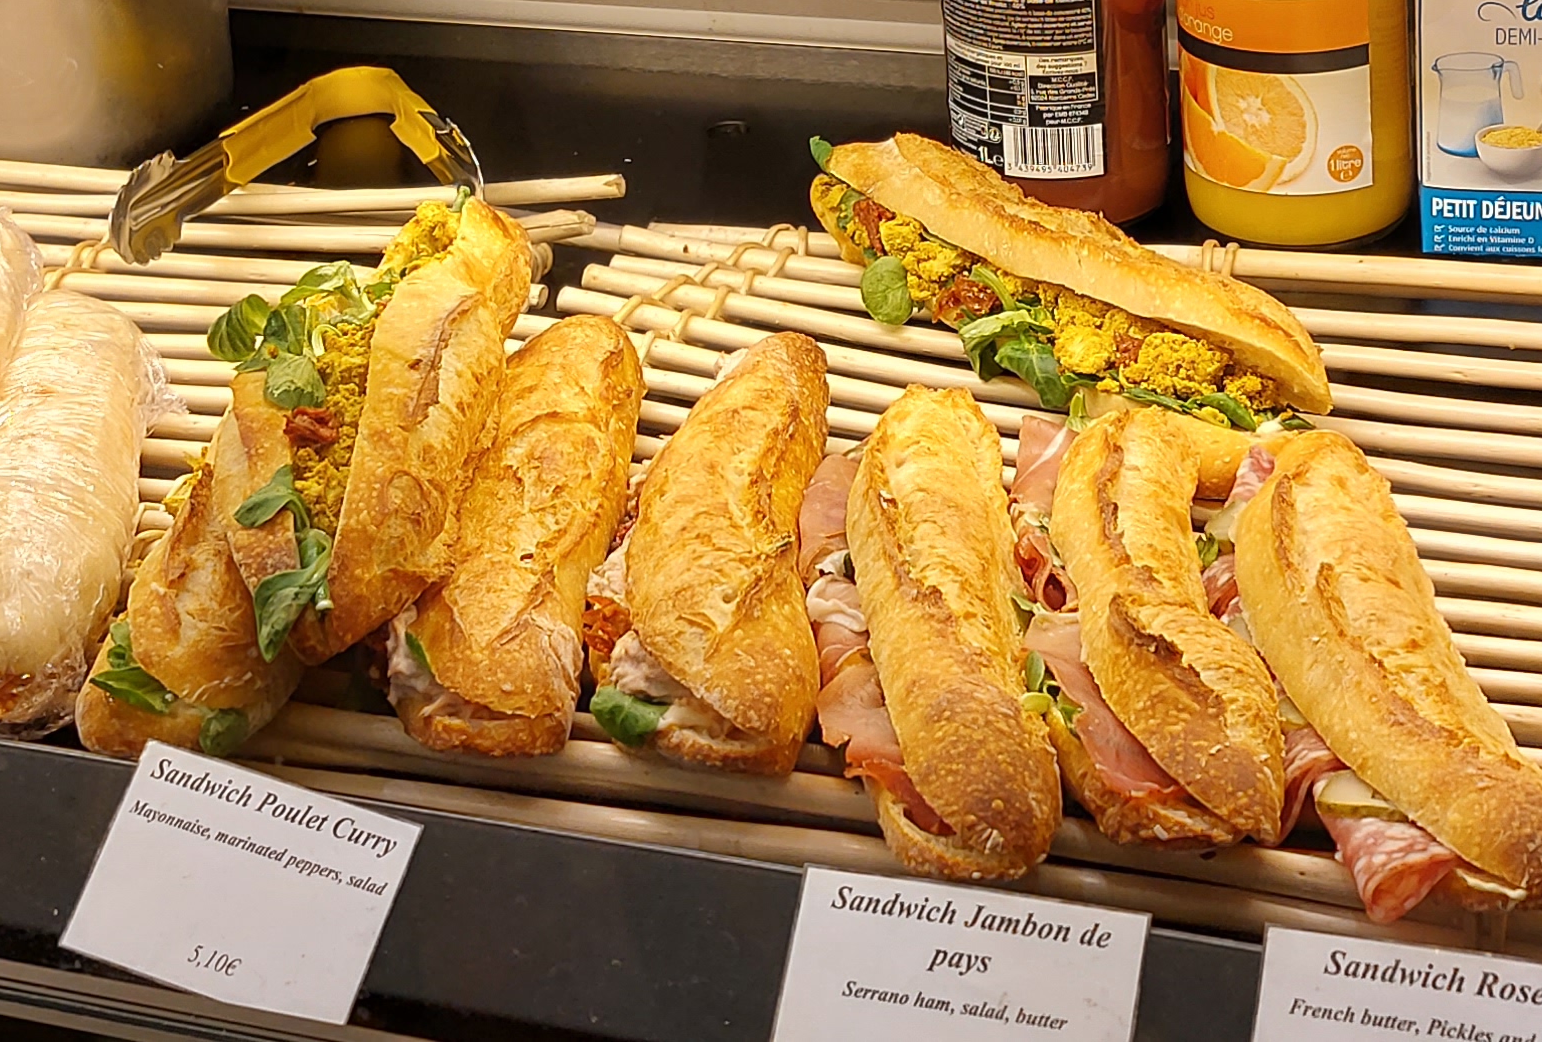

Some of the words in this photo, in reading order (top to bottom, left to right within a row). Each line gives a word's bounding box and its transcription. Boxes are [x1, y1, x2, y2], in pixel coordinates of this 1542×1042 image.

[1431, 197, 1478, 219] PETIT
[1448, 244, 1483, 252] Convient
[1476, 225, 1488, 234] de
[1489, 235, 1526, 244] Vitamine
[149, 757, 253, 808] Sandwich
[255, 791, 330, 833] Poulet
[331, 816, 398, 859] Curry
[129, 799, 211, 841] Mayonnaise,
[214, 830, 289, 862] marinated
[284, 853, 344, 885] peppers,
[346, 872, 389, 897] salad
[831, 885, 958, 925] Sandwich
[964, 904, 1072, 943] Jambon
[1079, 922, 1112, 949] de
[187, 943, 243, 977] 5,10€
[926, 947, 992, 976] pays
[1323, 949, 1466, 994] Sandwich
[842, 980, 910, 1006] Serrano
[913, 991, 956, 1015] ham,
[960, 1000, 1010, 1025] salad,
[1015, 1007, 1069, 1032] butter
[1289, 997, 1356, 1024] French
[1360, 1008, 1421, 1036] butter,
[1427, 1017, 1493, 1042] Pickles
